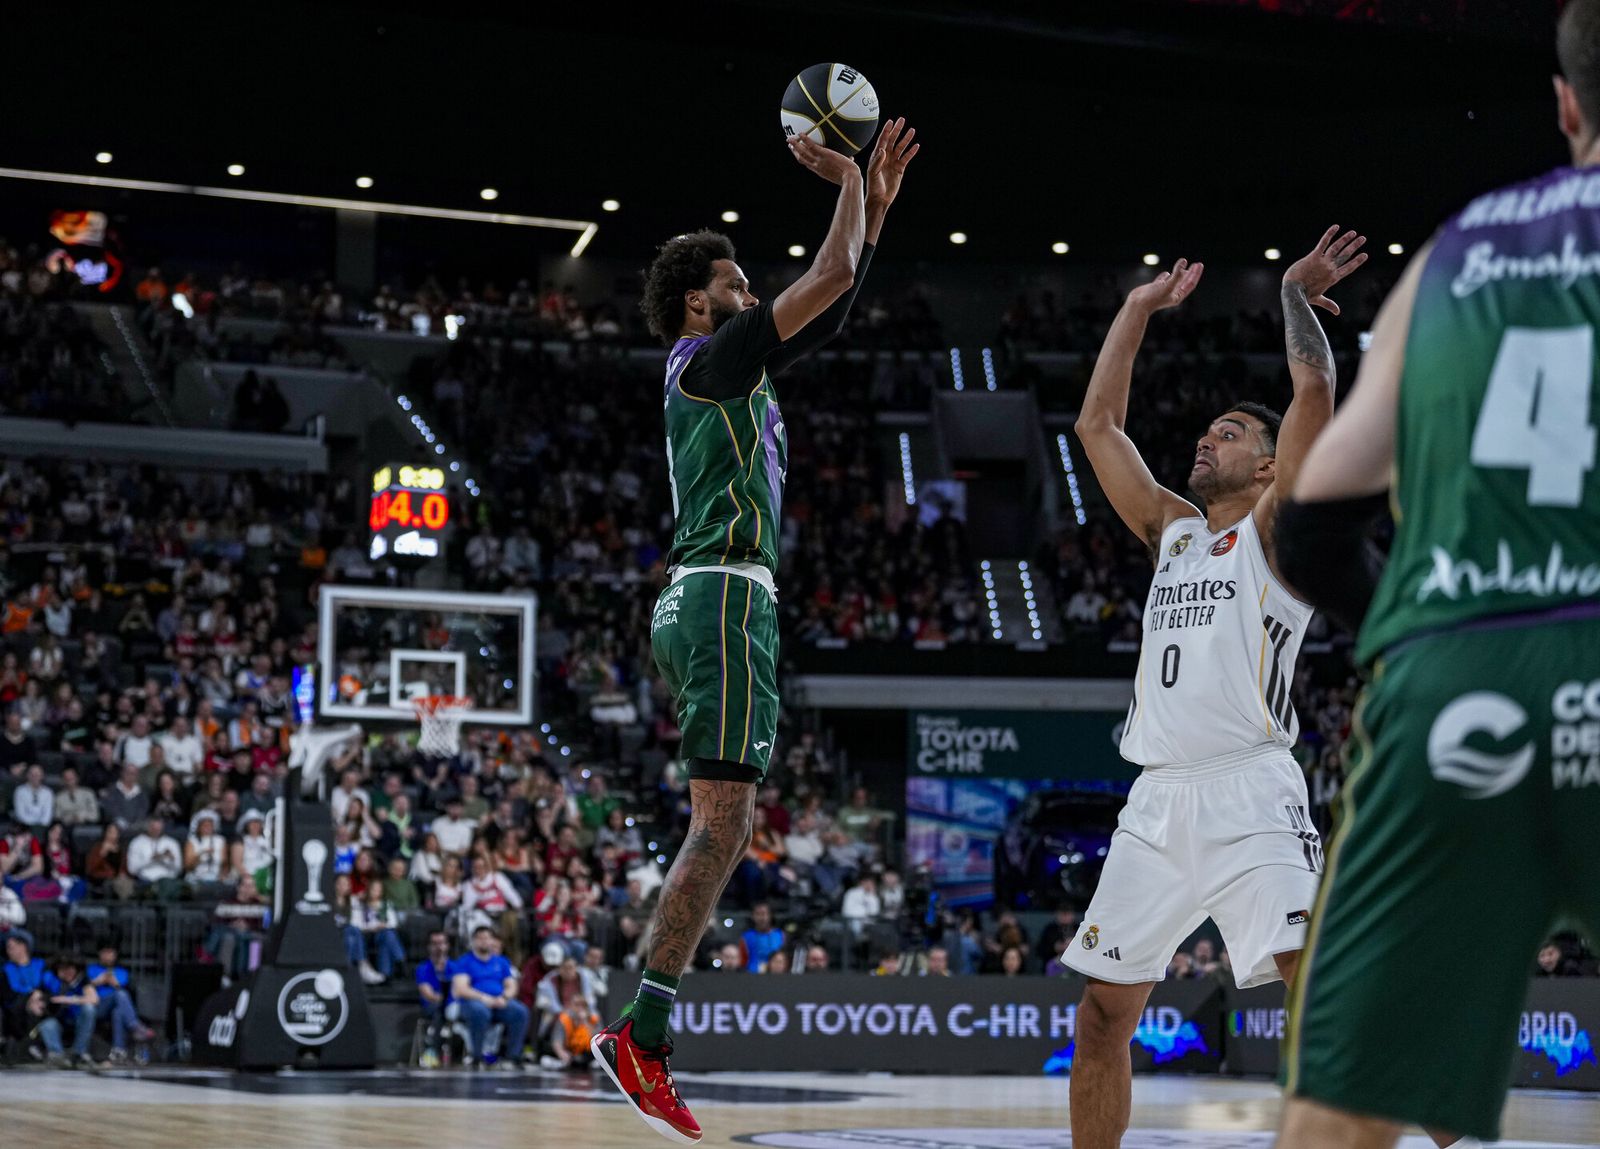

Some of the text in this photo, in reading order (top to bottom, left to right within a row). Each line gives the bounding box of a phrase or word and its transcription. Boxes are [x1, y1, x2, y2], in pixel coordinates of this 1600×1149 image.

[1470, 325, 1597, 507] 4
[1168, 605, 1215, 629] BETTER
[1161, 643, 1181, 689] 0
[917, 727, 1019, 750] TOYOTA
[917, 751, 983, 773] C-HR
[669, 1002, 1182, 1038] NUEVO TOYOTA C-HR HID
[1246, 1008, 1289, 1040] NUE
